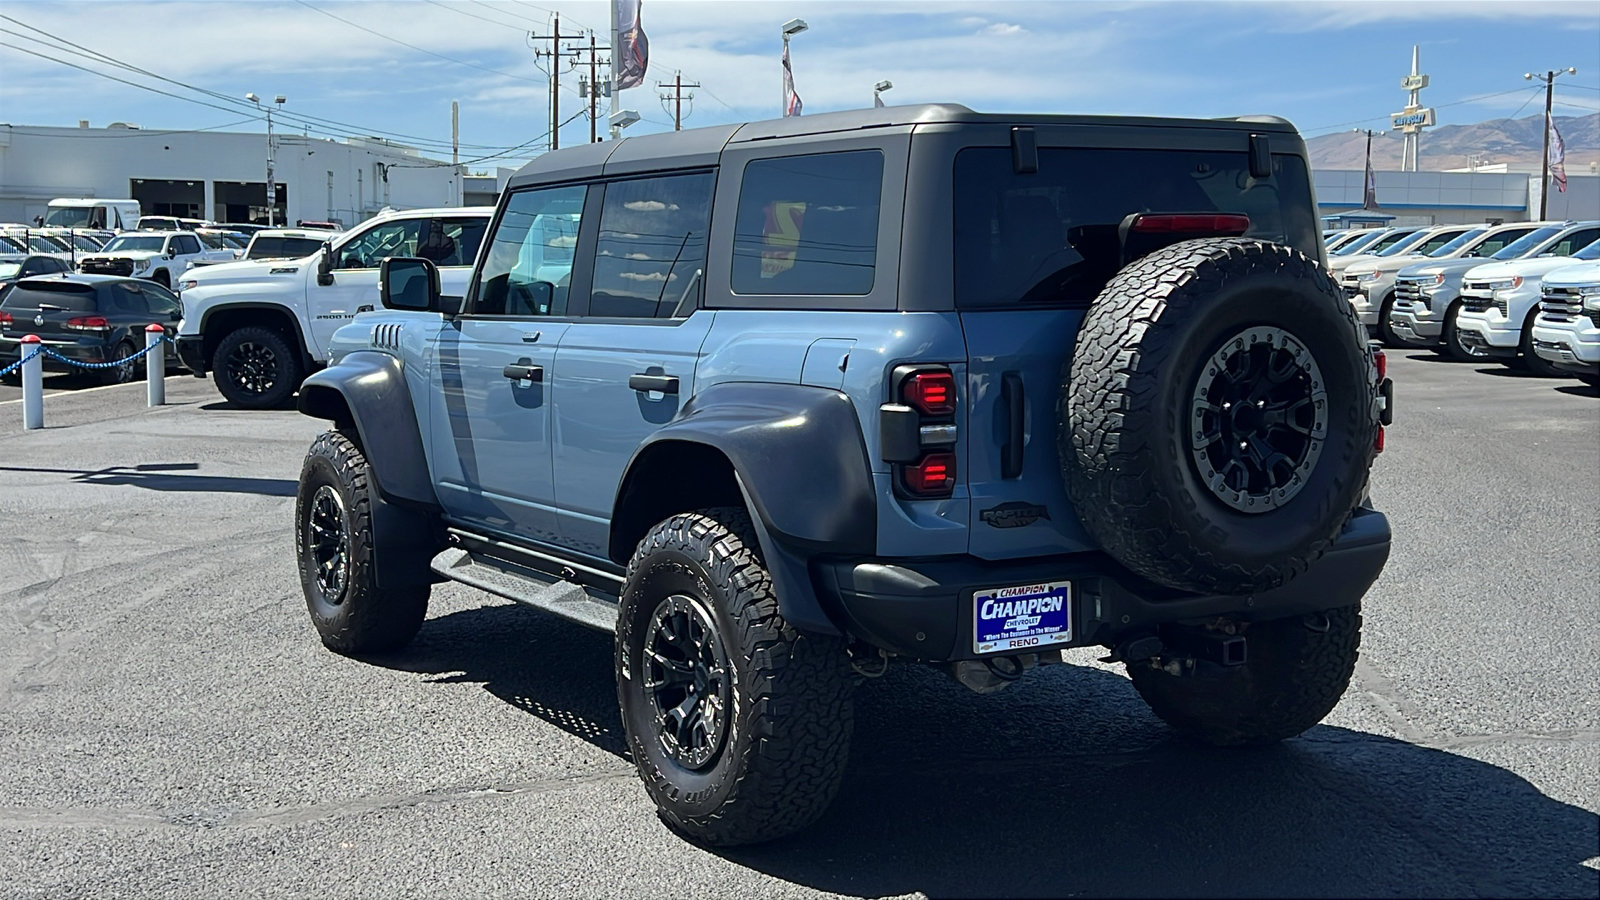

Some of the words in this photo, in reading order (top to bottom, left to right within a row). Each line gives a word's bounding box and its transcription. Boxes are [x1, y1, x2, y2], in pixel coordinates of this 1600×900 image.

[1001, 585, 1045, 597] CHAMPION
[981, 596, 1063, 620] CHAMPION
[1006, 617, 1039, 628] CHEVROLET
[1009, 637, 1040, 648] RENO
